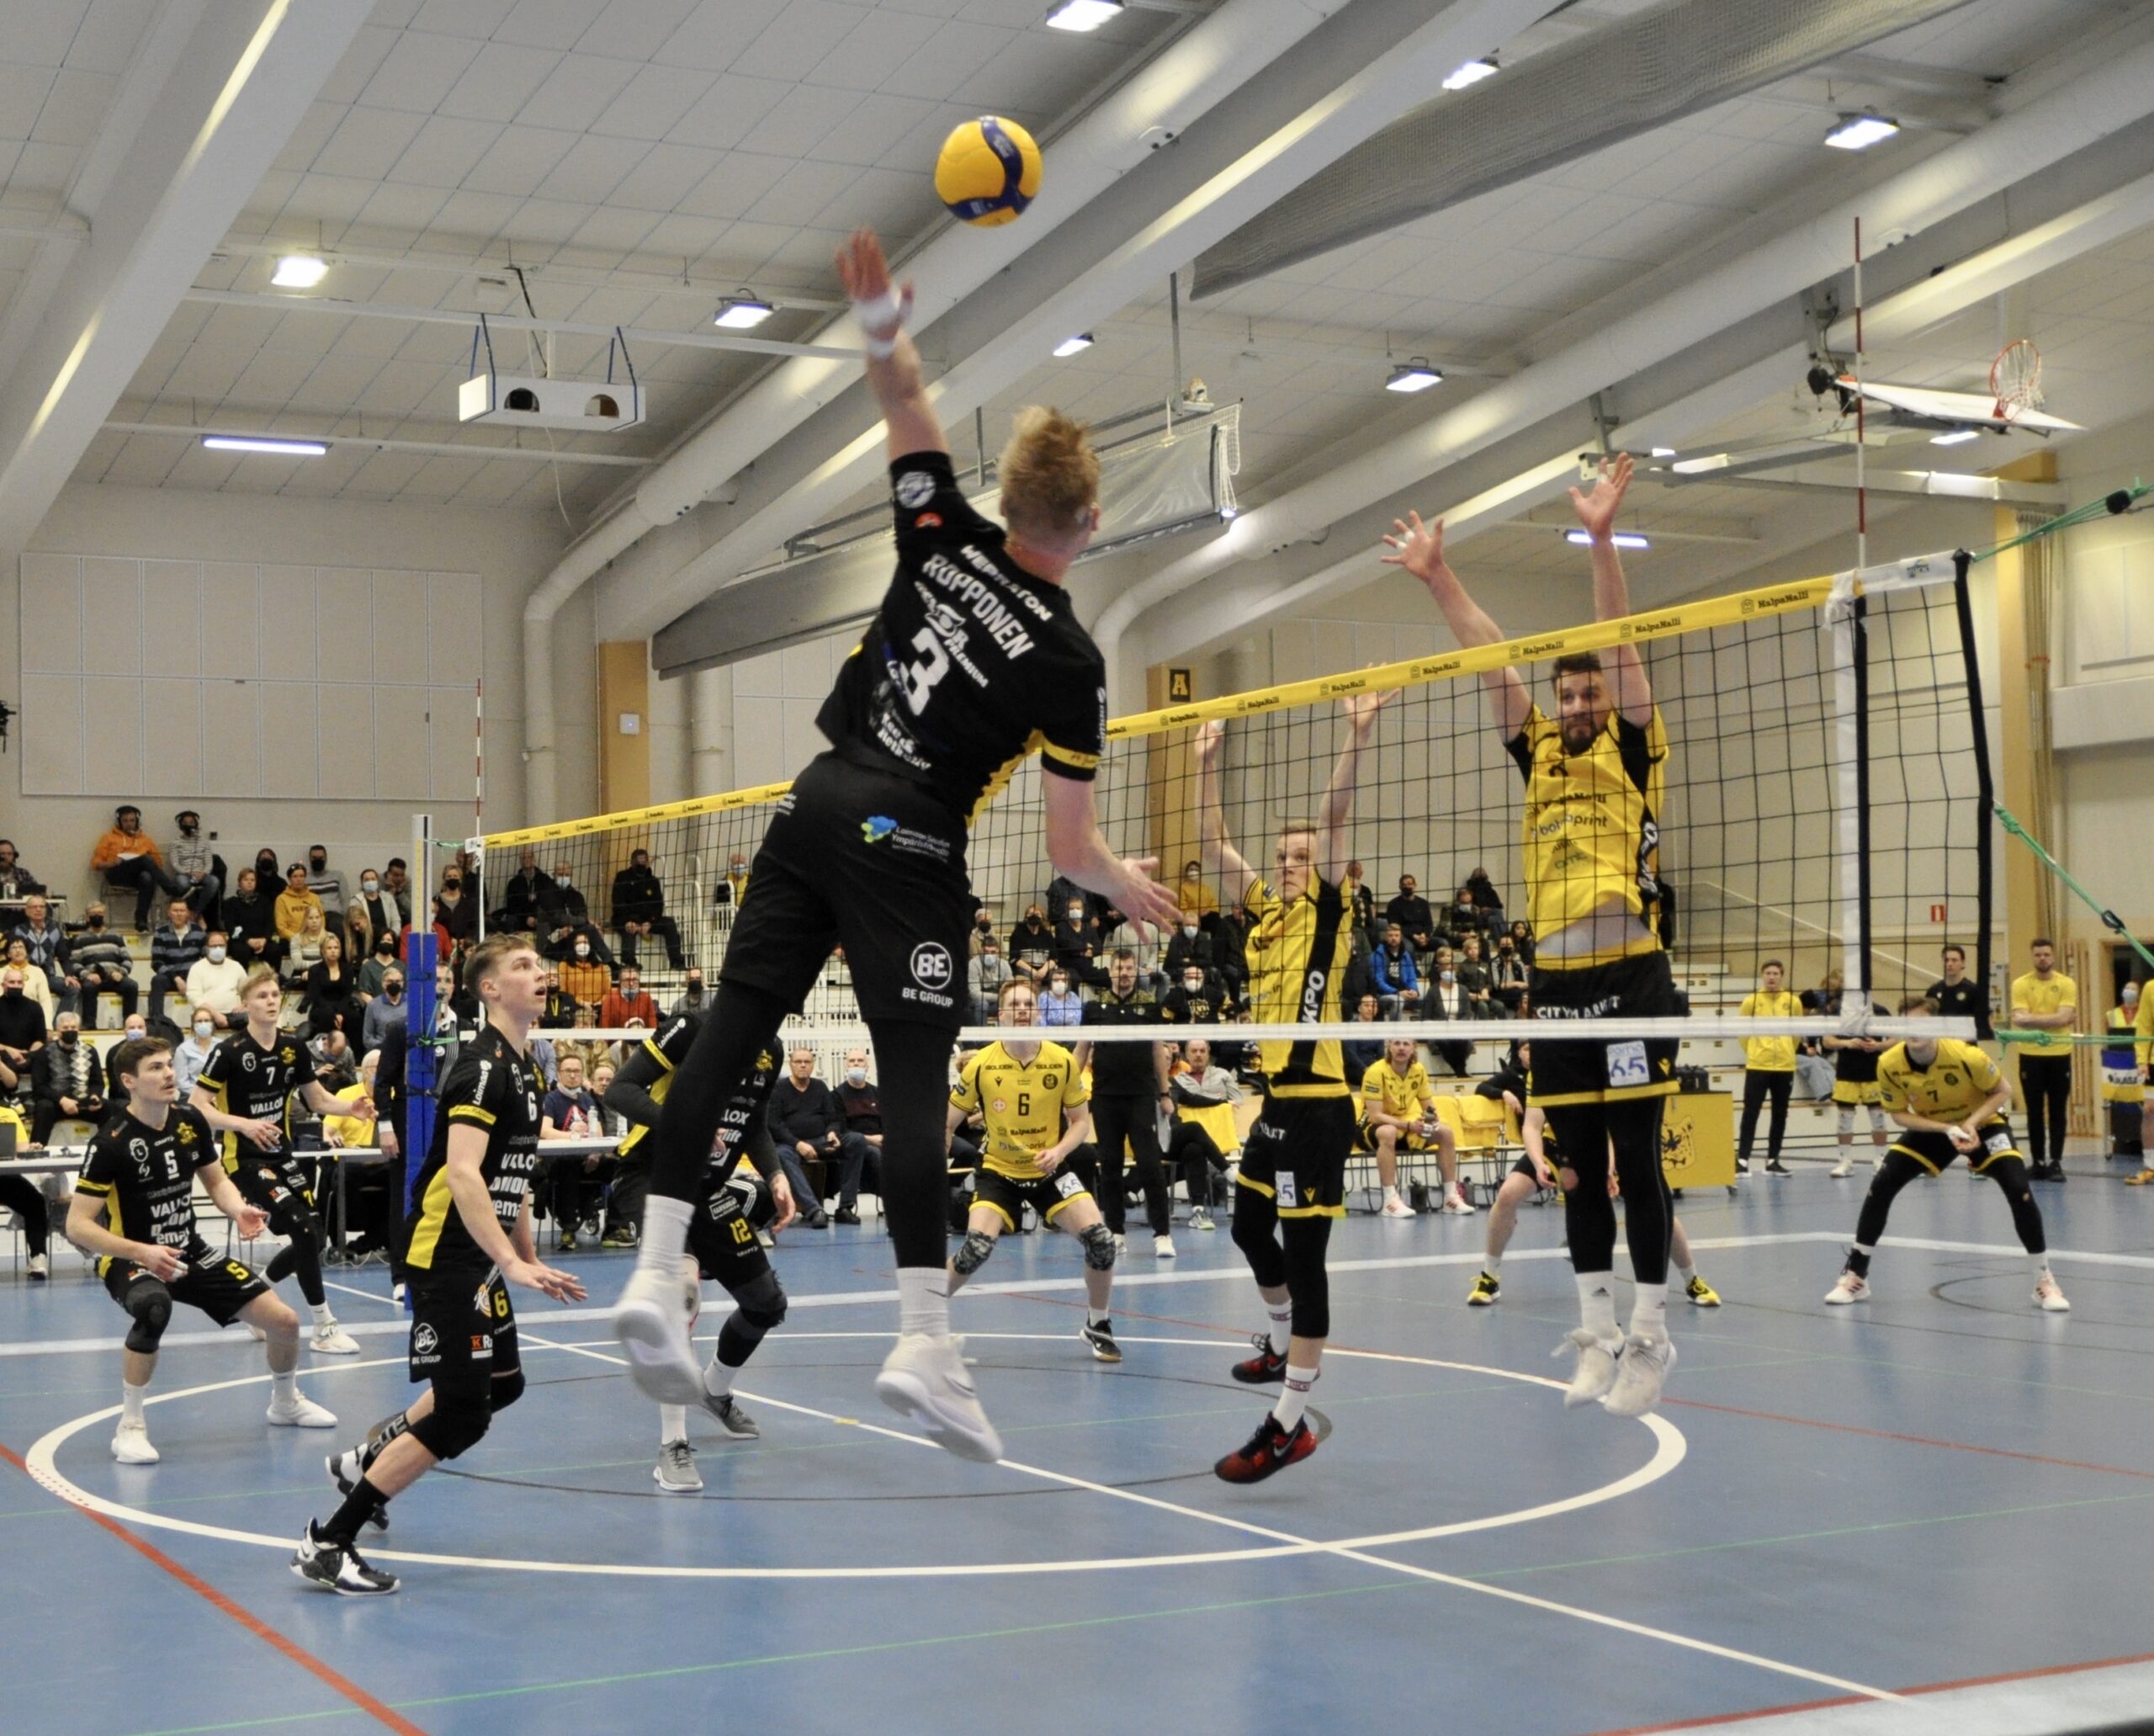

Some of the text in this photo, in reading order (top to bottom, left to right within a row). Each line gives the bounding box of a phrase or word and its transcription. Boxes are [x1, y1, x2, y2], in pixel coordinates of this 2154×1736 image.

[899, 627, 949, 716] 3
[1172, 673, 1188, 696] A
[916, 953, 947, 976] BE
[902, 987, 953, 1006] BE GROUP
[267, 1066, 275, 1086] 7
[473, 1070, 490, 1106] Loimaa
[528, 1091, 538, 1122] 6
[1018, 1093, 1030, 1116] 6
[164, 1149, 179, 1175] 5
[303, 1190, 314, 1207] 7
[729, 1218, 752, 1244] 12
[226, 1261, 250, 1280] 5
[494, 1290, 508, 1318] 6
[416, 1329, 435, 1347] BE
